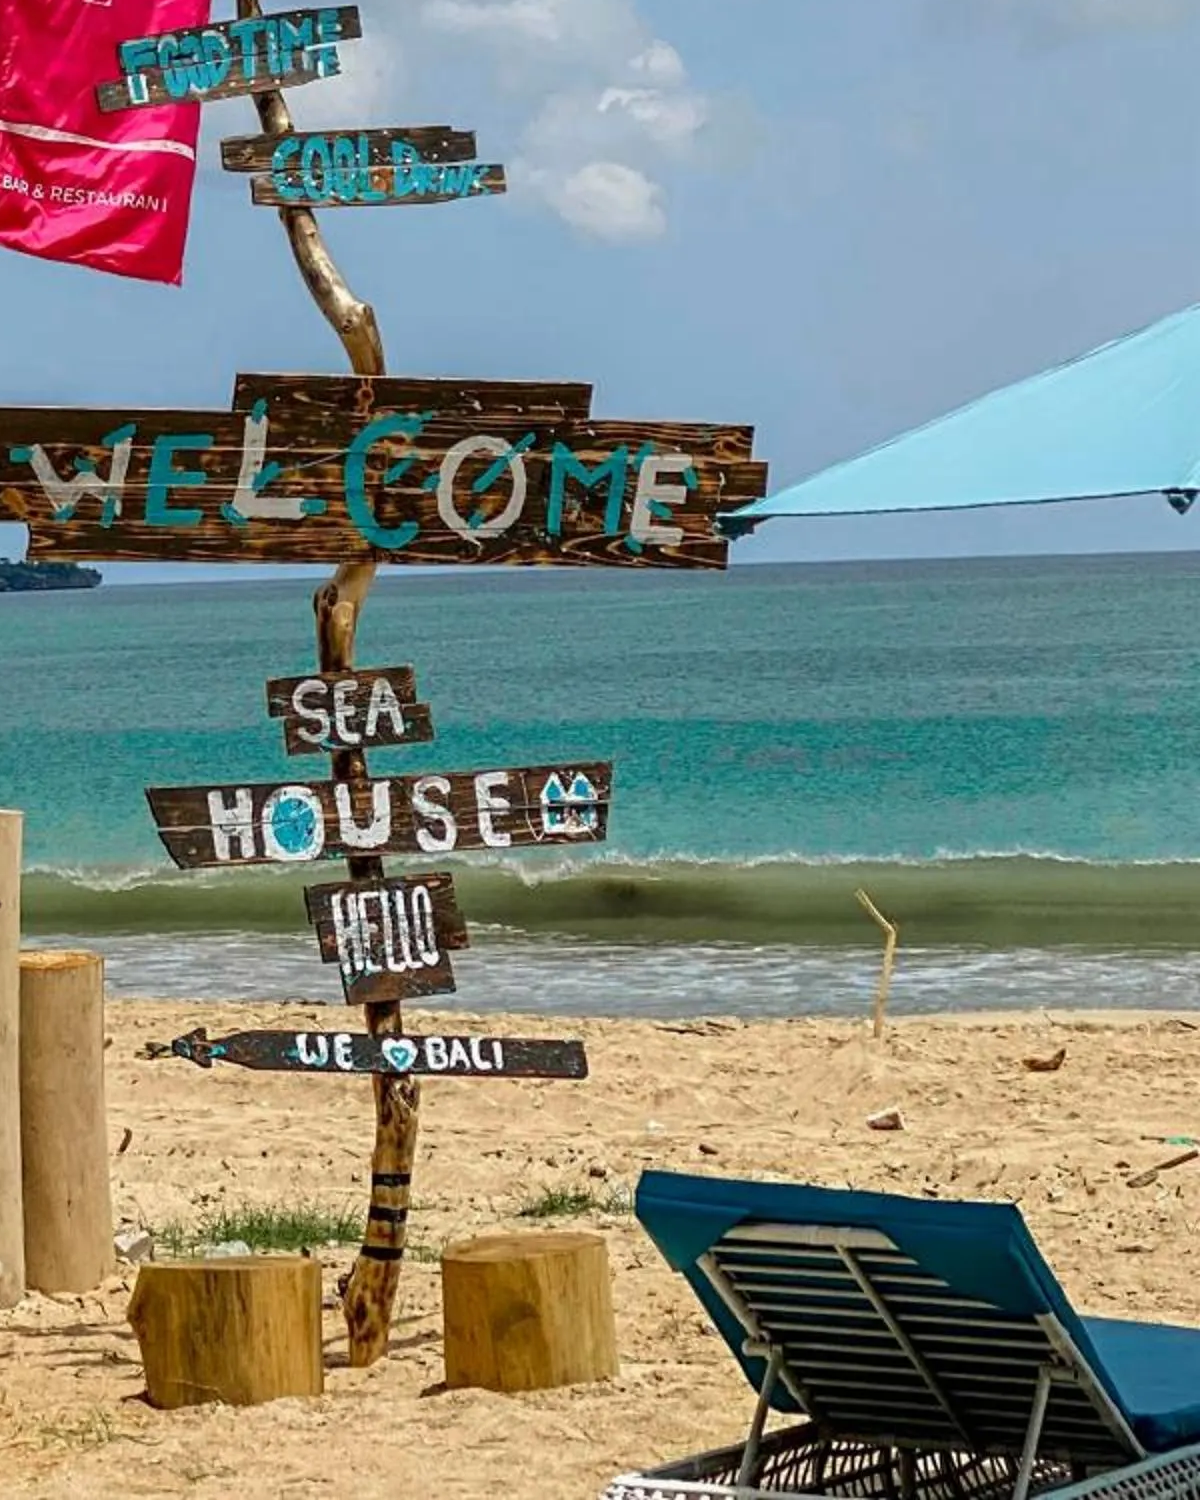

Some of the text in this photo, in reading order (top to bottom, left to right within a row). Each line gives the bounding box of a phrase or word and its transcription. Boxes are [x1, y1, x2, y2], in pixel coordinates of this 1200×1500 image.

[228, 8, 344, 80] TIME
[1, 174, 29, 197] BAR
[32, 184, 45, 200] &
[271, 132, 387, 202] COOL
[10, 398, 698, 554] WELCOME
[292, 677, 405, 745] SEA
[207, 771, 513, 861] HOUSE
[331, 885, 441, 976] HELLO
[295, 1033, 504, 1070] WE BALI
